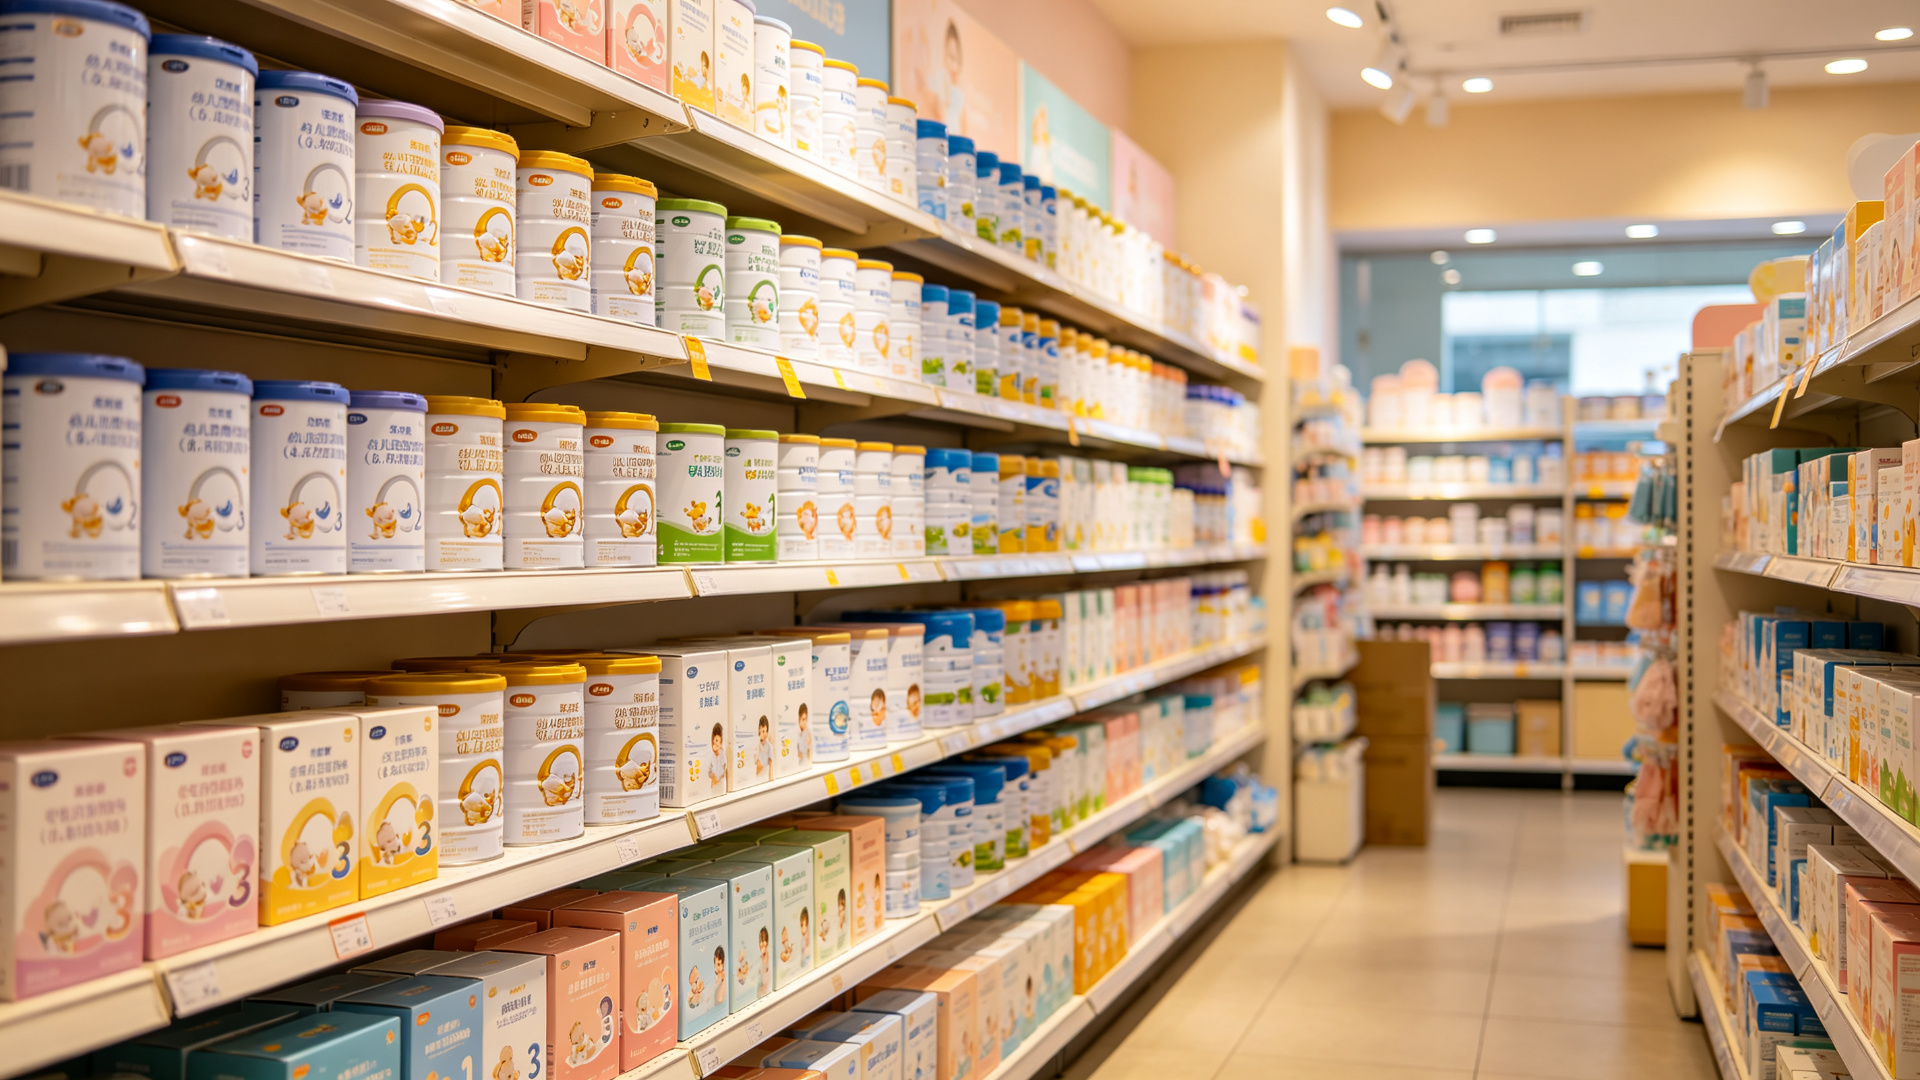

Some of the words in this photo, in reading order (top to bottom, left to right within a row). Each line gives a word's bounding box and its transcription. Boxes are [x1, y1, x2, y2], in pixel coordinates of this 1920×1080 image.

[415, 821, 432, 857] 3
[331, 841, 350, 880] 3
[228, 862, 250, 907] 3
[105, 891, 131, 940] 3
[527, 1042, 541, 1080] 3
